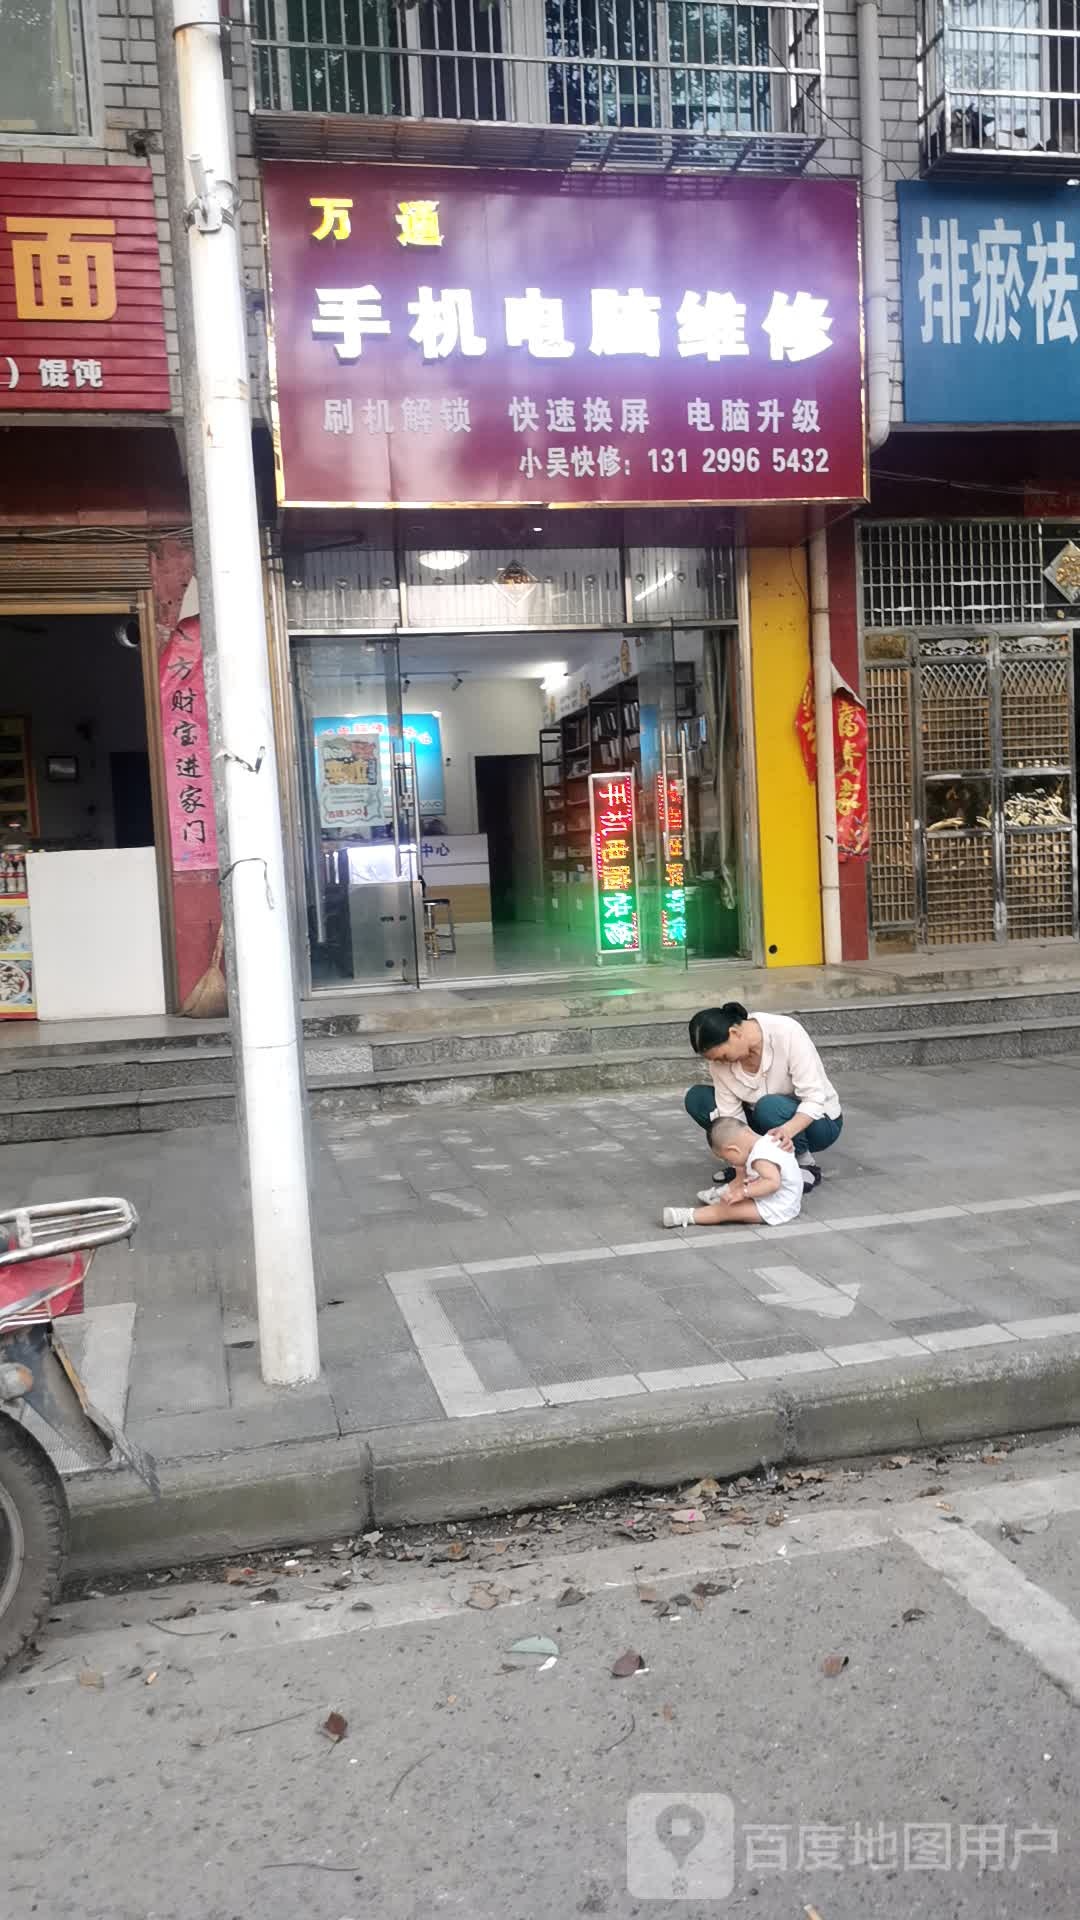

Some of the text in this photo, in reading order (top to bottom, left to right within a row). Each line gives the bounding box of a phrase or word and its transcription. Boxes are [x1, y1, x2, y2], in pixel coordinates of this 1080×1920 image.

[310, 197, 443, 247] 万通
[6, 216, 118, 320] 面
[916, 216, 1079, 344] 排瘀祛
[311, 284, 834, 362] 手机电脑维修
[323, 396, 821, 434] 刷机解锁 快速换屏 电脑升级
[649, 449, 688, 473] 131
[702, 447, 760, 473] 2996
[772, 447, 830, 473] 5432
[599, 782, 633, 945] 手机电脑快修
